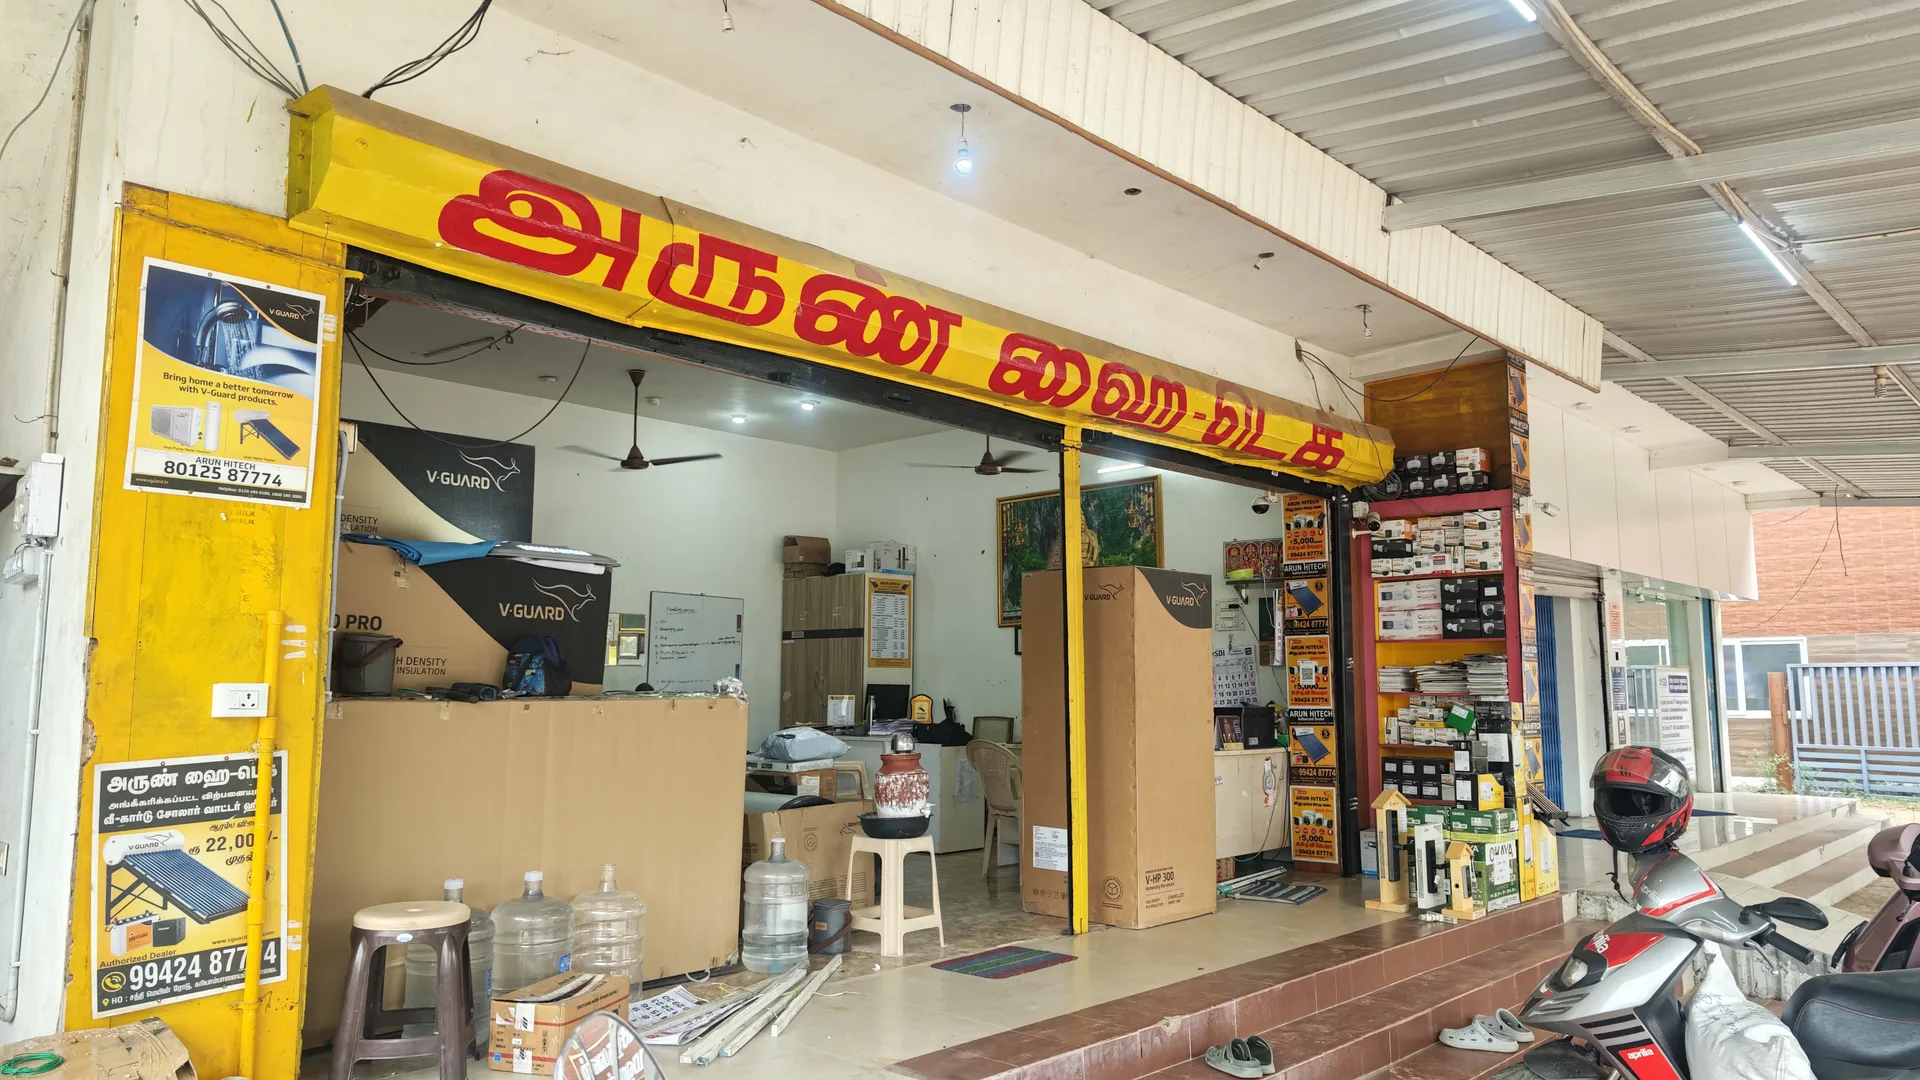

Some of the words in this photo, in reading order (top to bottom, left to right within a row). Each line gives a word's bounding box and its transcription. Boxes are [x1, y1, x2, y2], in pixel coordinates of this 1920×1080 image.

[438, 169, 963, 375] அருண்
[269, 308, 299, 320] V-GUARD
[163, 371, 187, 384] Bring
[189, 377, 213, 388] home
[222, 381, 250, 393] better
[252, 386, 294, 399] tomorrow
[179, 385, 198, 395] with
[201, 387, 236, 400] V-Guard
[238, 392, 278, 407] products.
[195, 456, 221, 466] ARUN
[223, 460, 256, 470] HITECH
[163, 460, 221, 480] 80125
[227, 469, 283, 487] 87774
[426, 470, 490, 490] V-GUARD
[340, 513, 379, 525] DENSITY
[1304, 563, 1327, 571] HITECH
[1166, 595, 1194, 607] V-GUARD
[499, 603, 565, 621] V-GUARD
[345, 614, 382, 631] PRO
[406, 656, 447, 667] DENSITY
[396, 667, 446, 676] INSULATION
[1299, 769, 1317, 777] 99424
[1318, 768, 1336, 776] 87774
[107, 767, 179, 794] அருண்
[157, 805, 200, 820] சோலார்
[204, 801, 240, 814] வாட்டர்
[128, 842, 159, 851] V-GUARD
[206, 830, 279, 854] 22,00/-
[1298, 848, 1315, 856] 99424
[1145, 872, 1162, 885] V-HP
[1163, 871, 1175, 883] 300
[1640, 883, 1661, 904] aprilia
[100, 953, 148, 969] Authorized
[150, 949, 177, 960] Dealer
[129, 954, 201, 991] 99424
[209, 941, 277, 975] 8774
[111, 996, 123, 1005] HO
[641, 1003, 652, 1011] 16
[1627, 1047, 1655, 1060] aprilia
